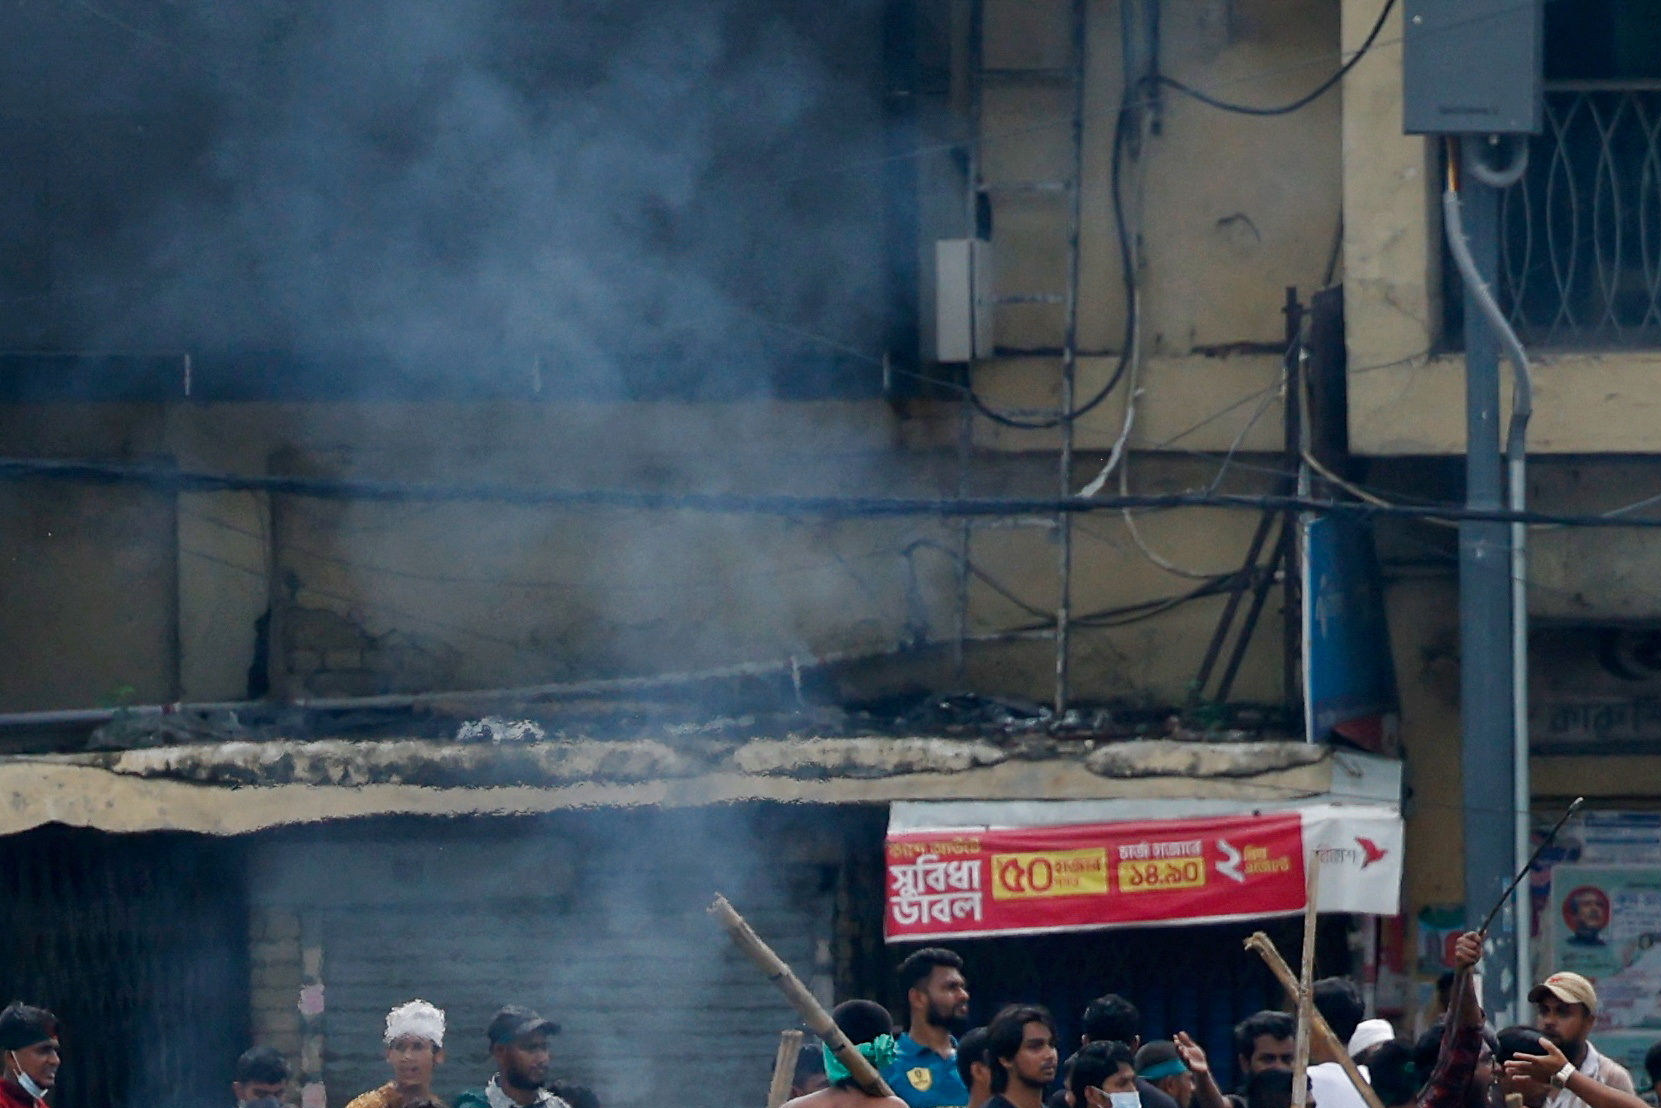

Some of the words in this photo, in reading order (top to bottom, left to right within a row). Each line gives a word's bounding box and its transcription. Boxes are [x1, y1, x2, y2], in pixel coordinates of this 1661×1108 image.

[888, 854, 982, 897] সুবিধা
[1001, 857, 1053, 892] ৫০
[1129, 862, 1199, 887] ১৪.৯০
[1215, 840, 1246, 883] ২
[888, 891, 983, 924] ডাবল
